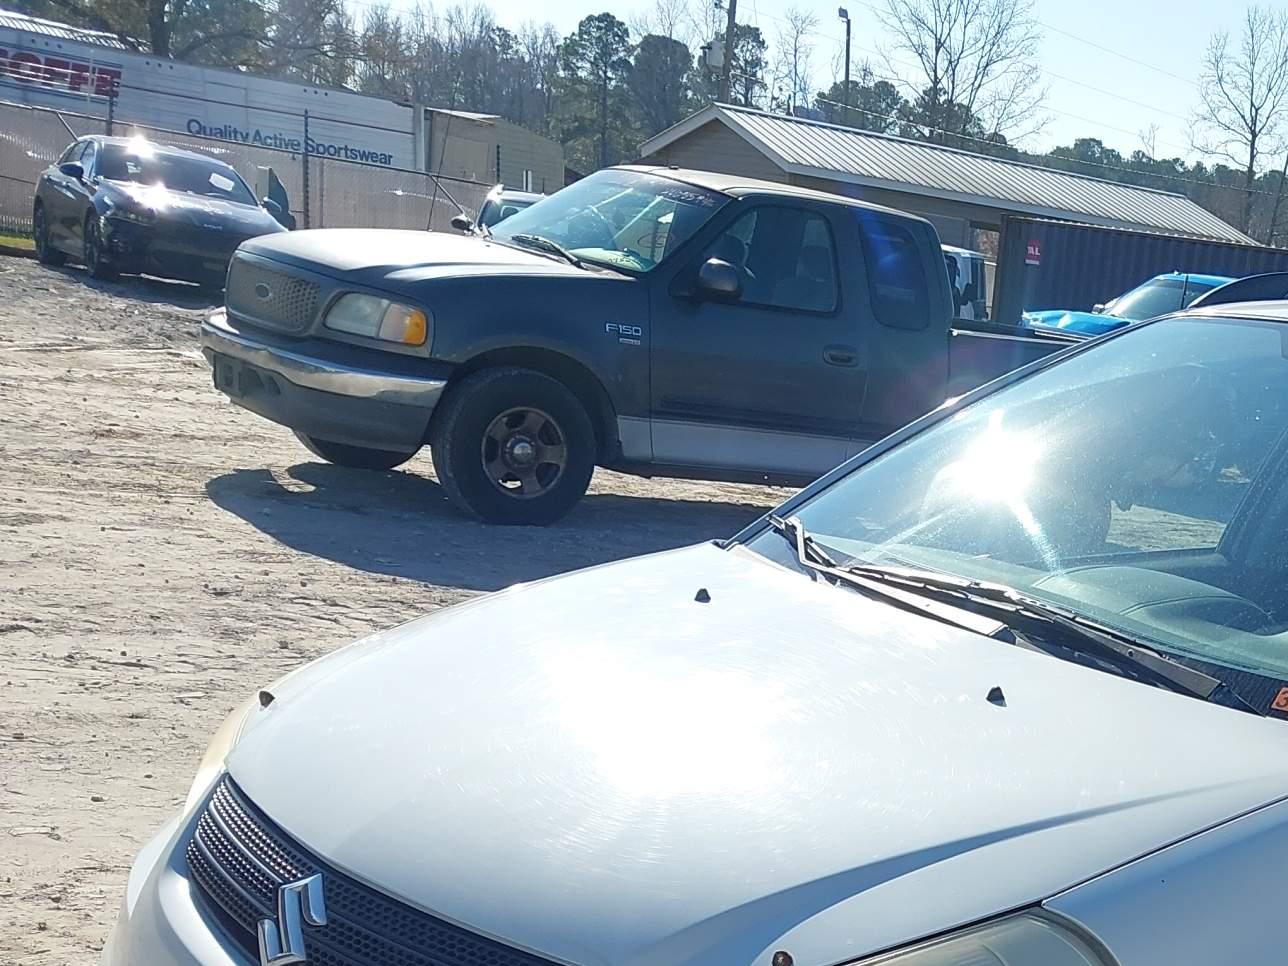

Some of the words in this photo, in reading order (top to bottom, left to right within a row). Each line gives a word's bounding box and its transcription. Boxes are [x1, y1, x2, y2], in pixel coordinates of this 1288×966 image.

[186, 118, 248, 143] Quality
[251, 128, 301, 150] Active
[304, 136, 393, 165] Sportswear
